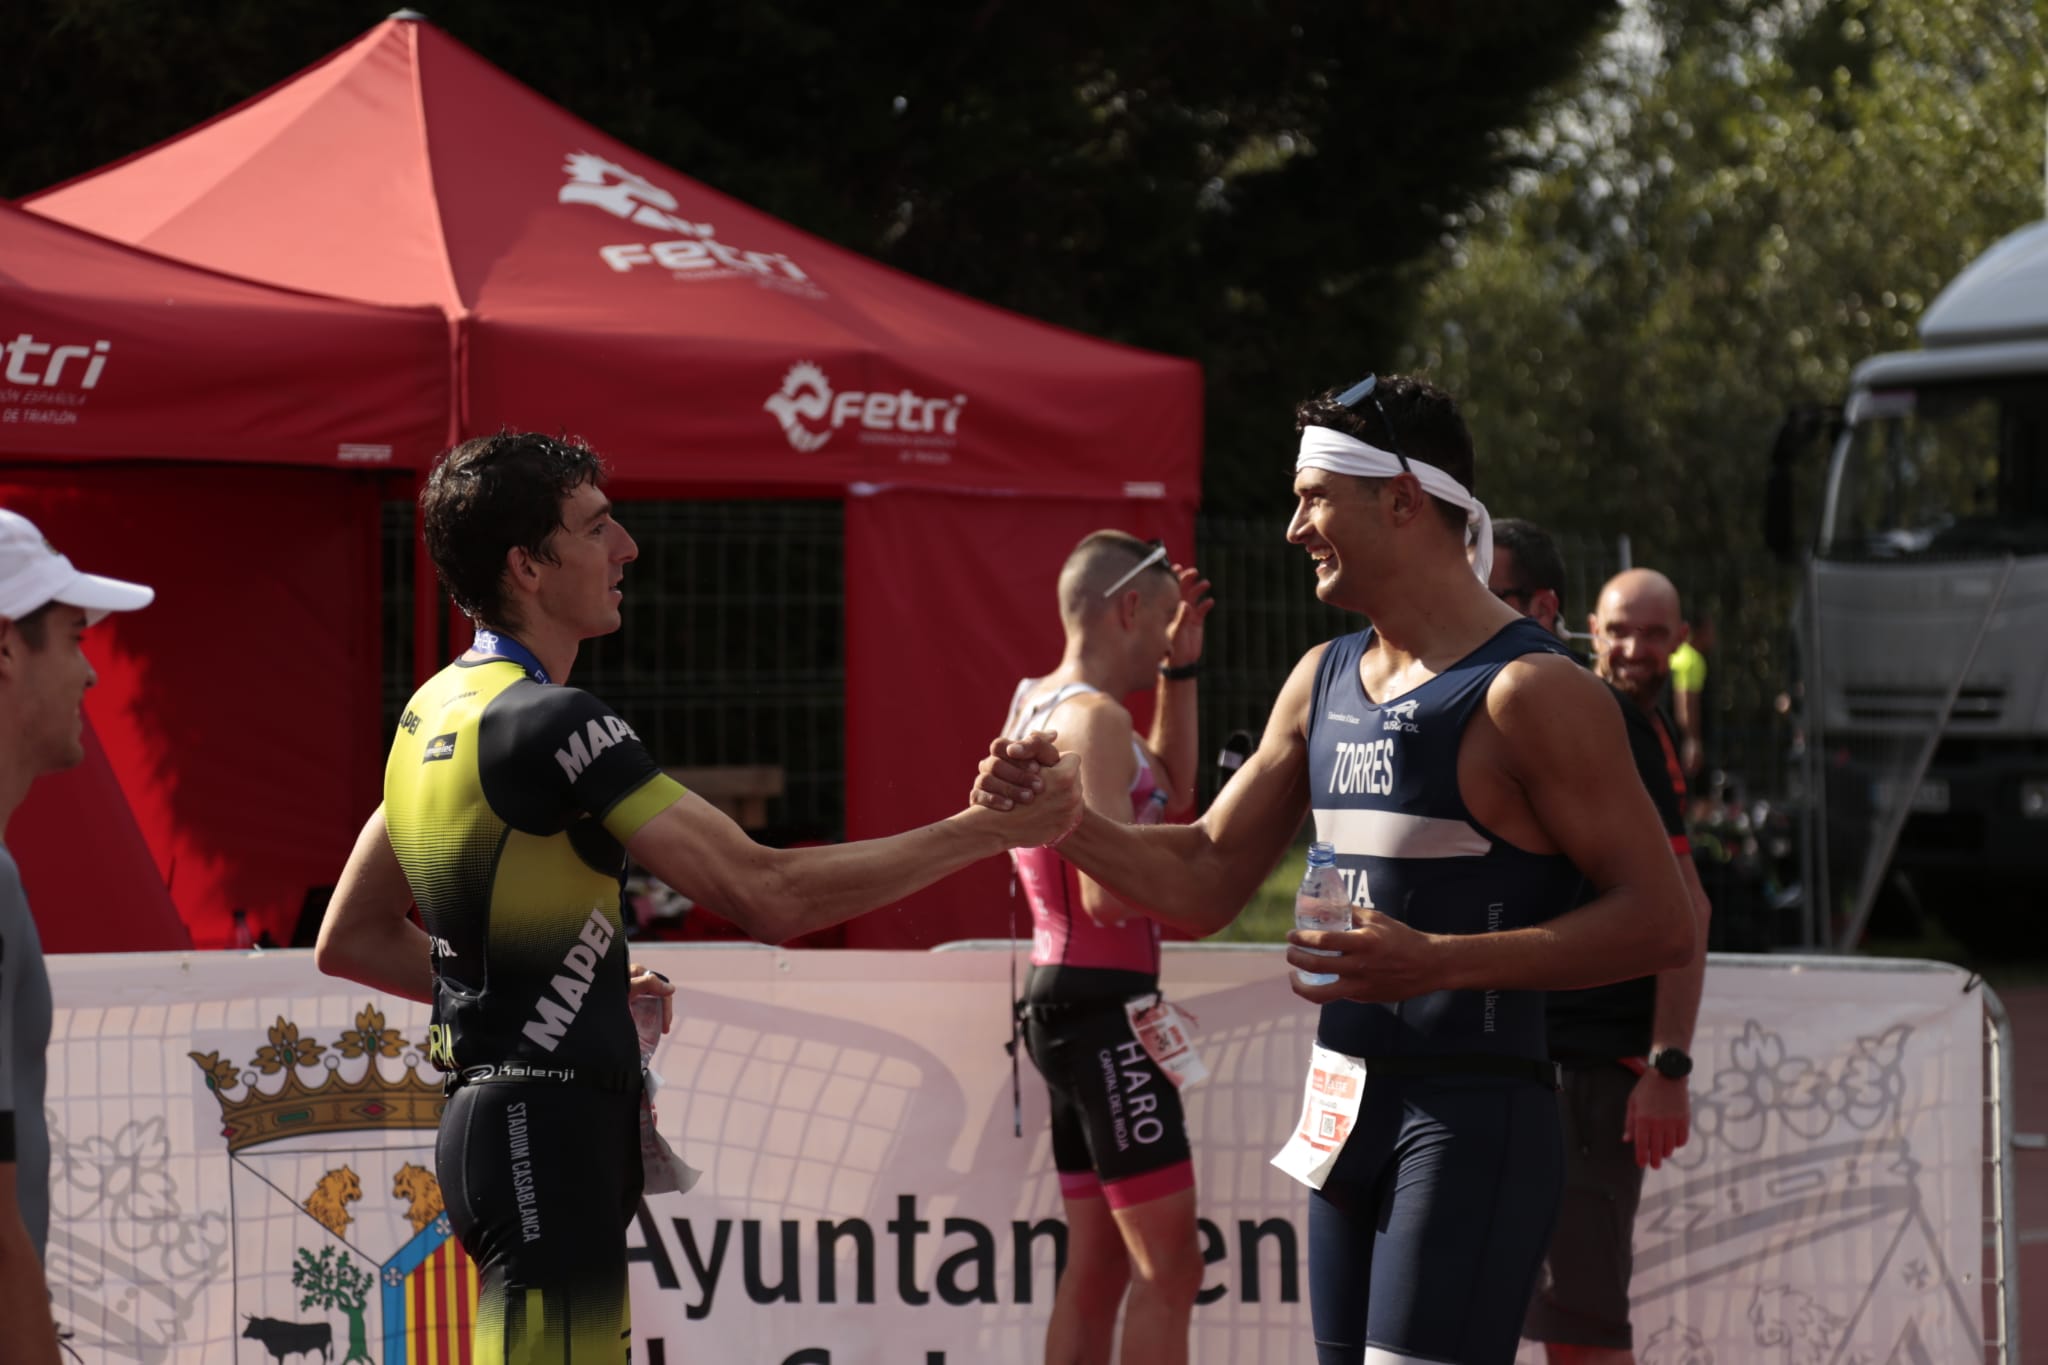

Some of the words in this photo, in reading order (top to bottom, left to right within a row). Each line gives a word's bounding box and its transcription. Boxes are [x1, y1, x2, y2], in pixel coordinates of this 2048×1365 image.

[0, 333, 111, 390] tri
[1328, 738, 1394, 796] TORRES
[522, 908, 615, 1053] MAPEI
[1099, 1049, 1117, 1091] CAPITAL
[1117, 1040, 1164, 1145] HARO
[507, 1101, 530, 1160] STADIUM
[1110, 1093, 1123, 1116] DEL
[1114, 1116, 1130, 1152] RIOJA
[511, 1160, 541, 1244] CASABLANCA
